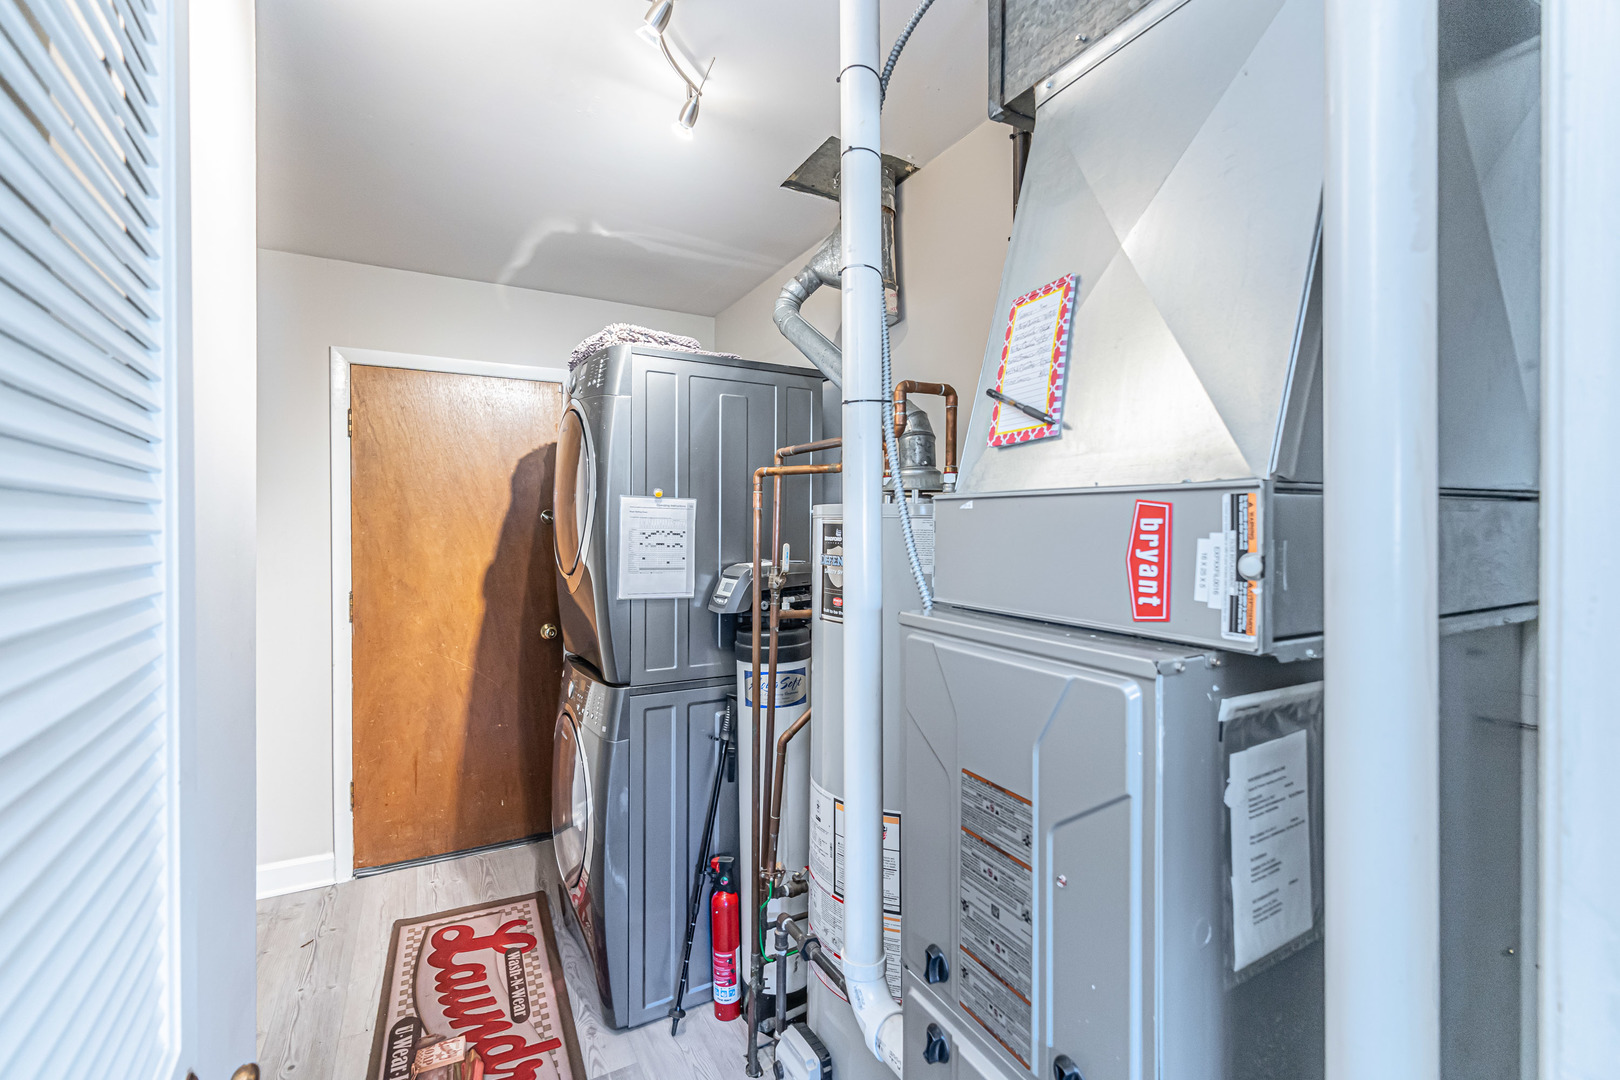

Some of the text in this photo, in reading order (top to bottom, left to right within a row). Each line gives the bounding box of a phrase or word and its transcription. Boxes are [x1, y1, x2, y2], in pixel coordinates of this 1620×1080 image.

[1135, 518, 1163, 607] bryant
[780, 676, 802, 690] Soft
[506, 950, 527, 1017] Wash-N-Wear
